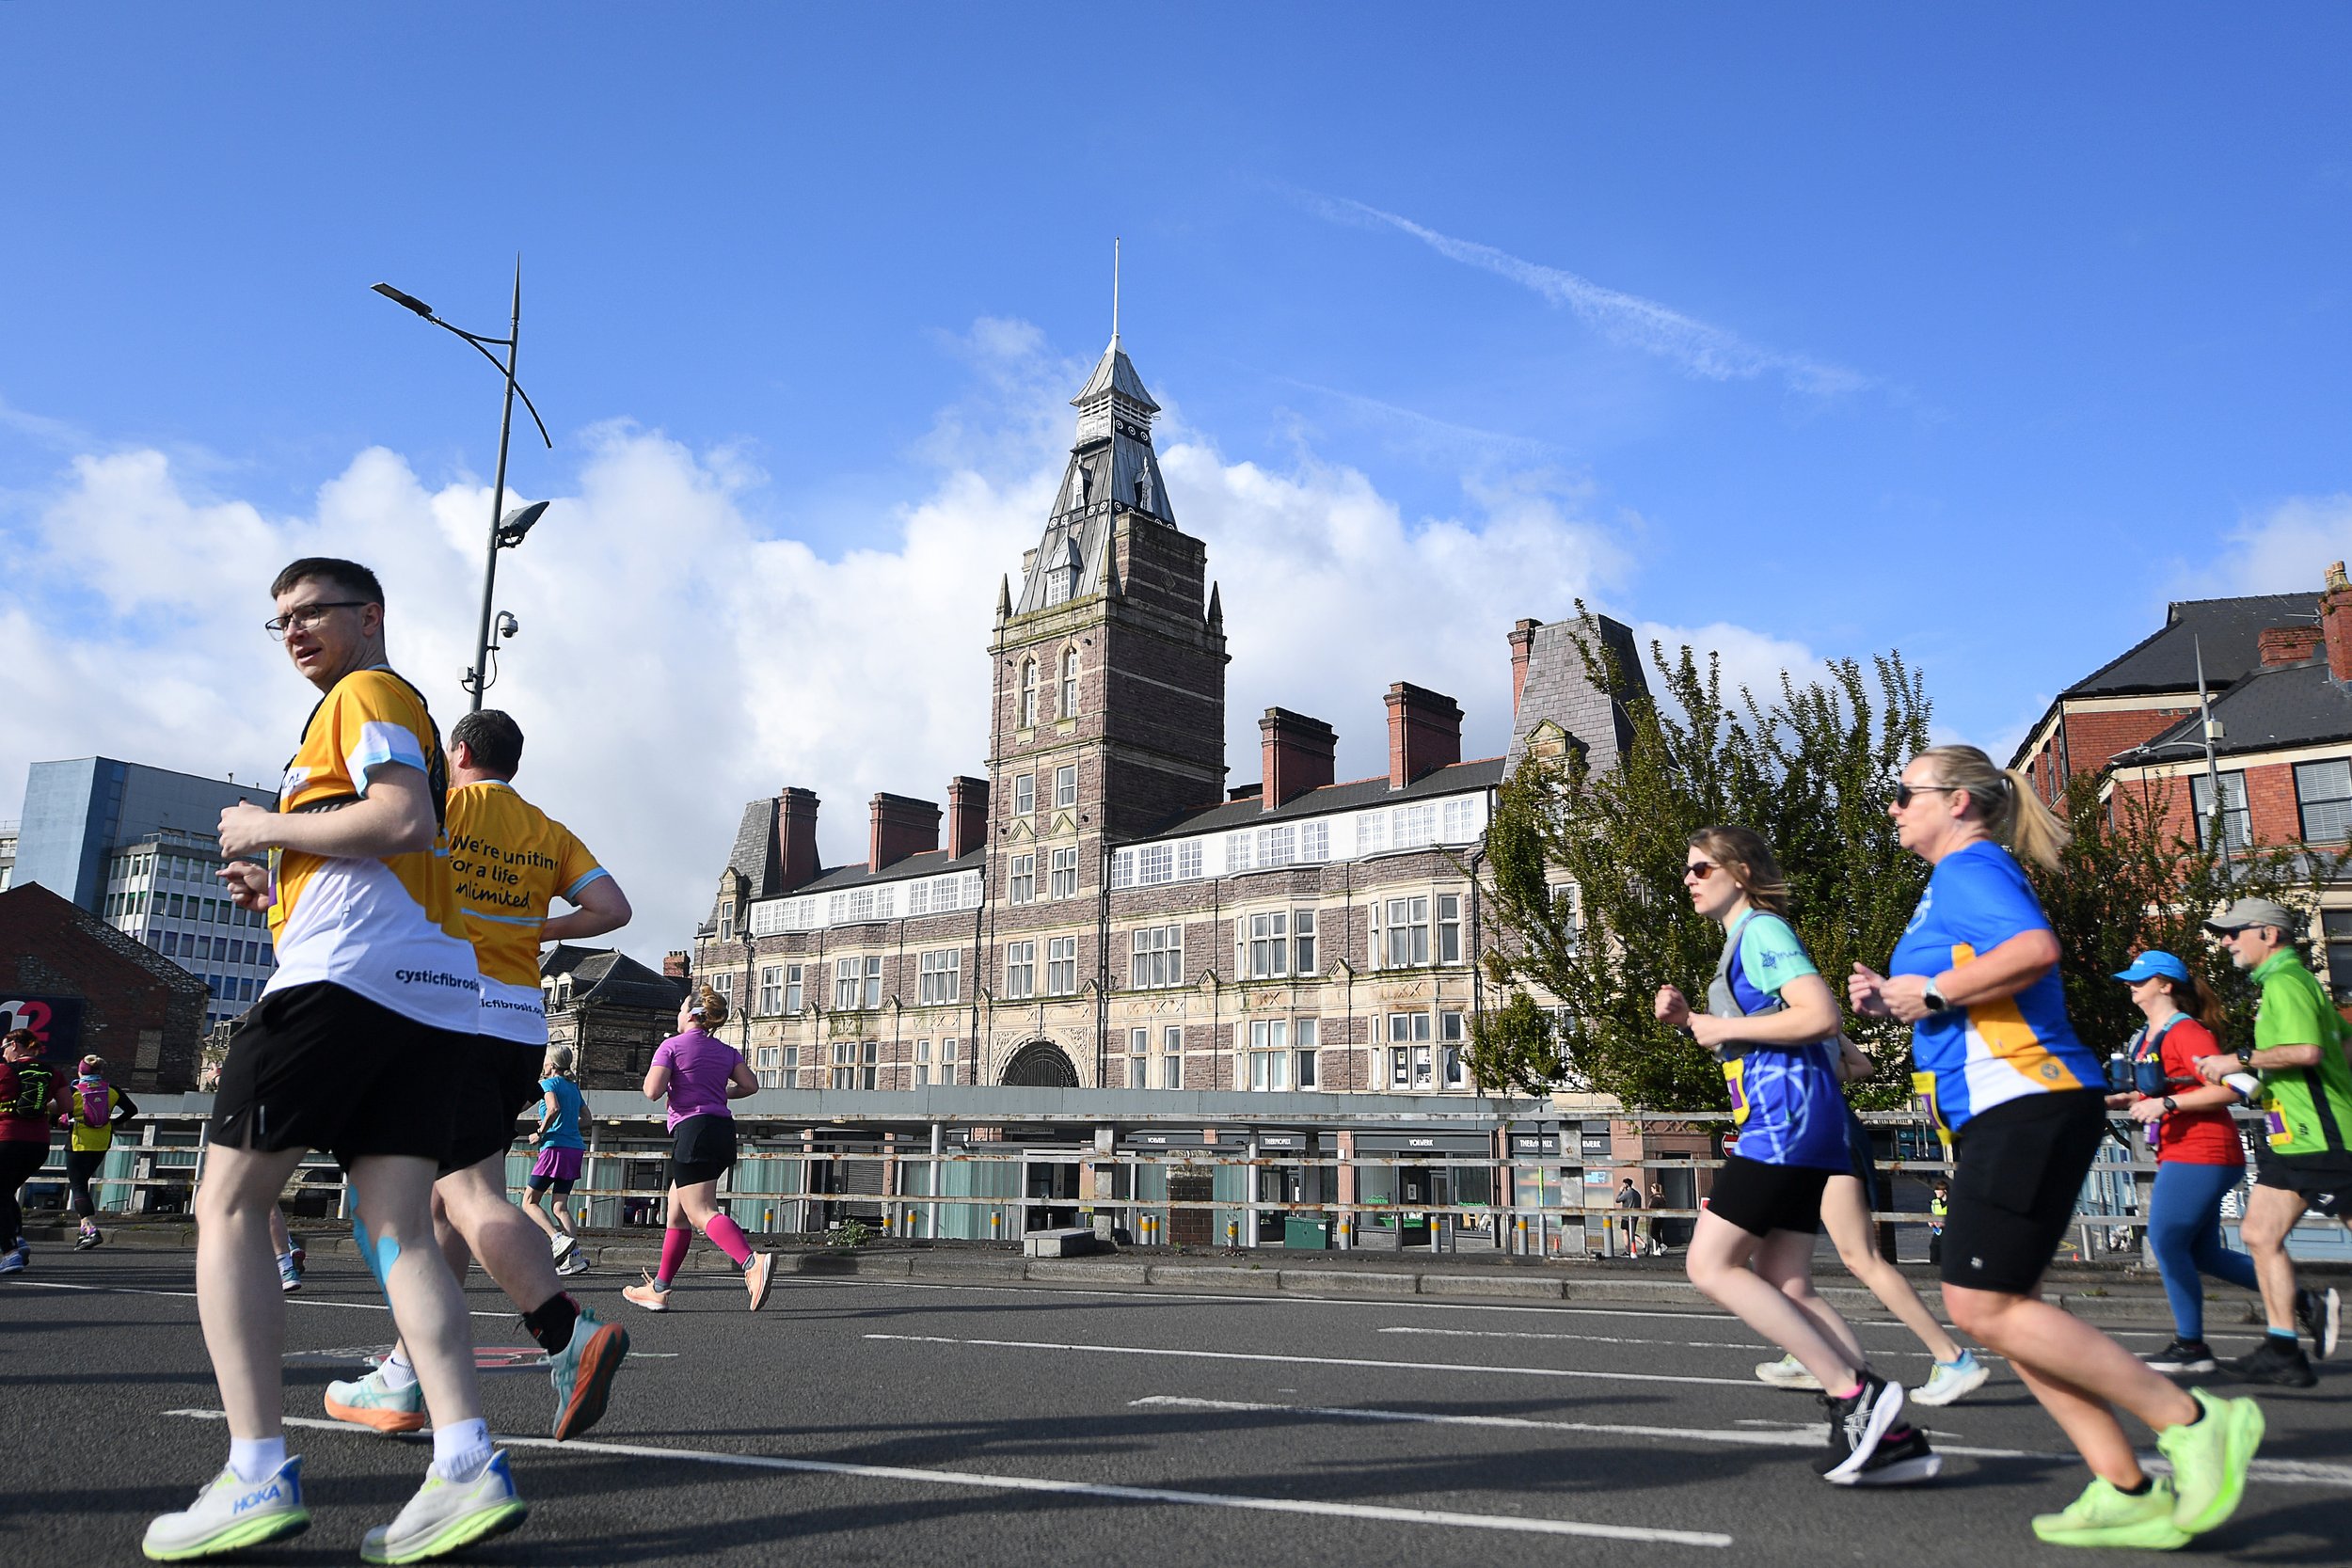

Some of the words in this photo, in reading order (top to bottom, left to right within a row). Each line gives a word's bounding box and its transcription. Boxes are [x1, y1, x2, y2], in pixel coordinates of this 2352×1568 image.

[453, 835, 500, 860] We're
[476, 865, 486, 878] a
[492, 865, 518, 884] life
[455, 880, 531, 910] nlimited
[1408, 1138, 1434, 1147] VORWERK
[1519, 1139, 1553, 1148] THERMMIX
[233, 1484, 280, 1514] HOKA
